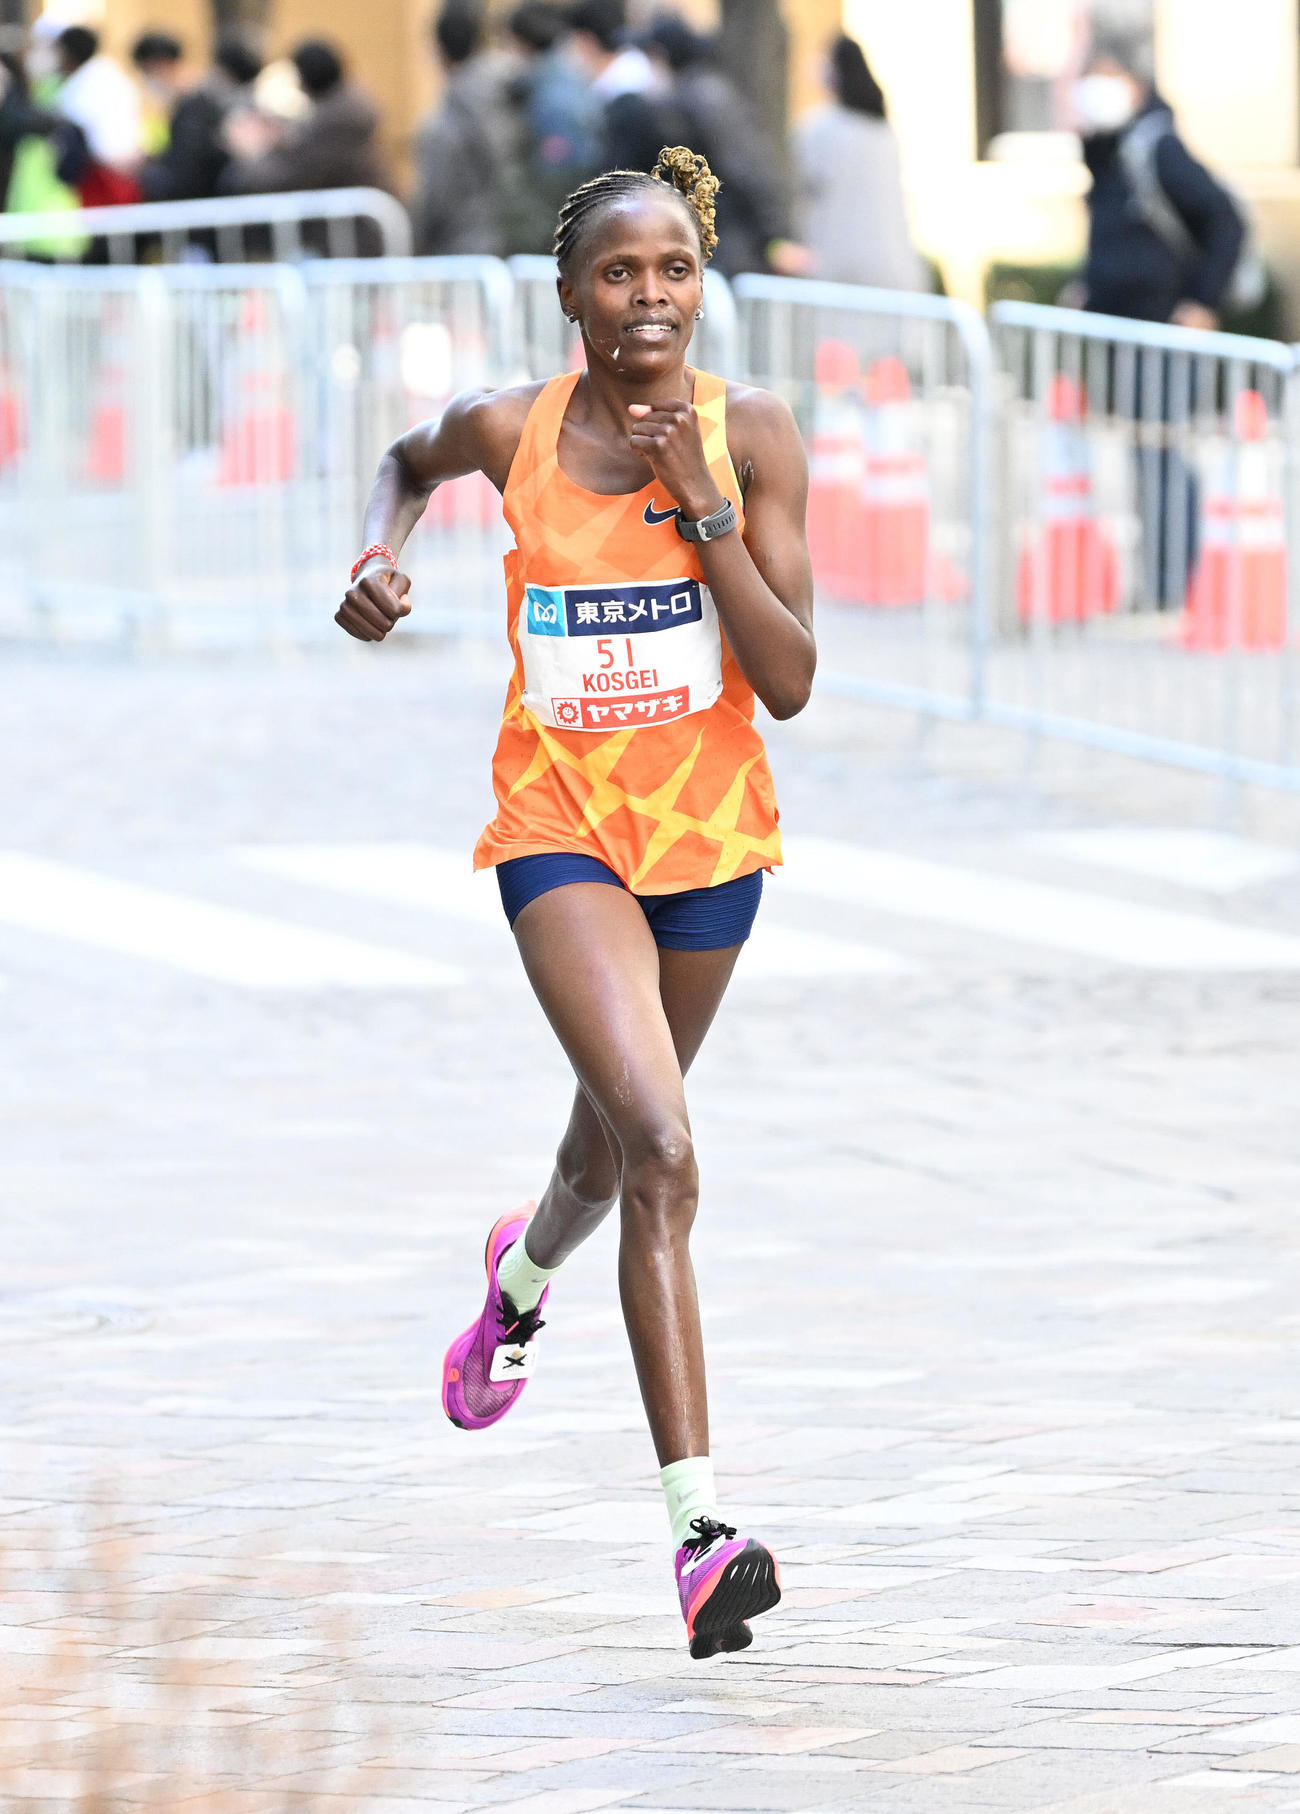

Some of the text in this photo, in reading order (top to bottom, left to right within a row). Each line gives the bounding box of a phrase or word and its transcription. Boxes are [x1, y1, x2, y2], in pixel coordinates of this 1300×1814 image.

[575, 591, 692, 625] 東京メトロ
[597, 638, 634, 669] 51
[582, 669, 659, 692] KOSGEI
[587, 694, 683, 723] ヤマザキ
